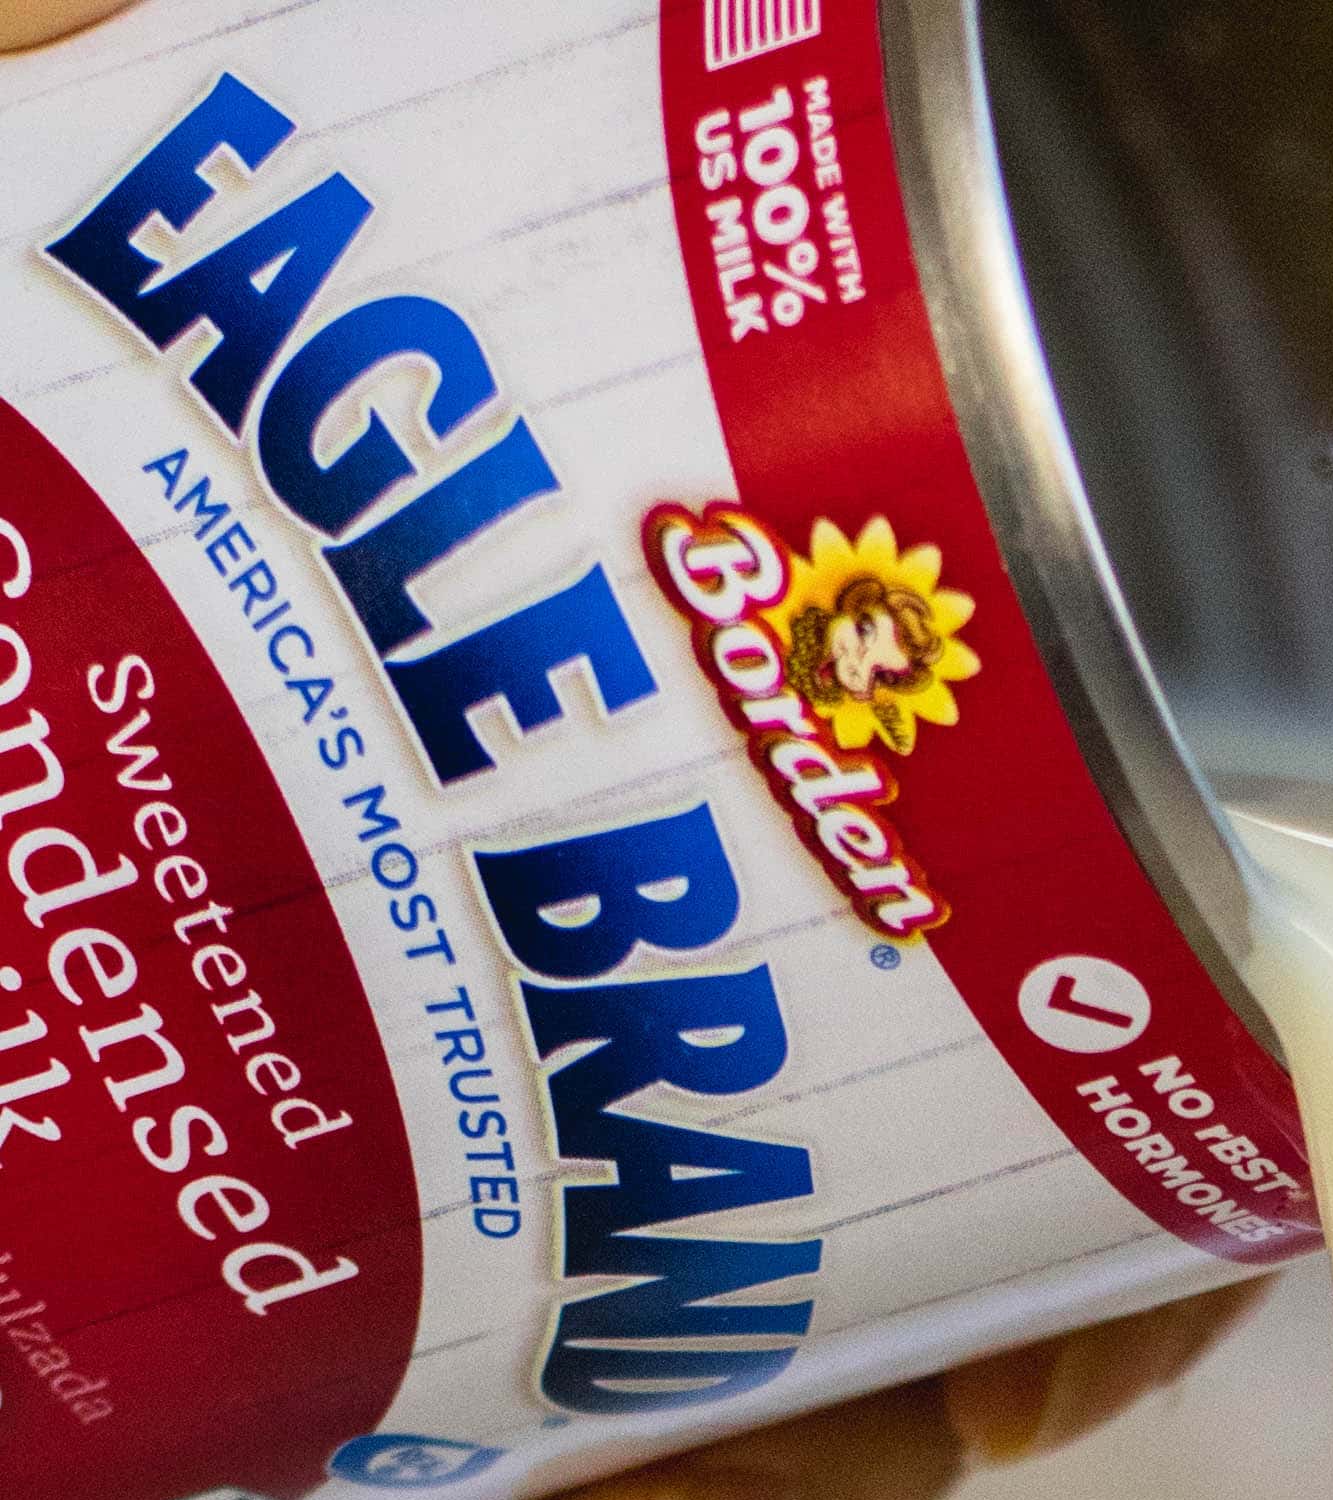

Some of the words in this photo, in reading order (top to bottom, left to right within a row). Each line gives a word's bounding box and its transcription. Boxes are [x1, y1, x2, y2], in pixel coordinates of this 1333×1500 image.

[694, 107, 737, 190] US
[738, 85, 828, 328] 100%
[804, 75, 842, 190] MADE
[705, 196, 769, 343] MILK
[822, 191, 866, 304] WITH
[45, 72, 660, 787] EAGLE
[473, 800, 823, 1415] BRAND
[652, 506, 944, 938] Borden
[87, 654, 354, 1150] Sweetened
[143, 447, 364, 770] AMERICA'S
[343, 785, 456, 966] MOST
[425, 984, 522, 1239] TRUSTED
[1076, 1075, 1289, 1243] HORMONES
[1138, 1055, 1214, 1119] NO
